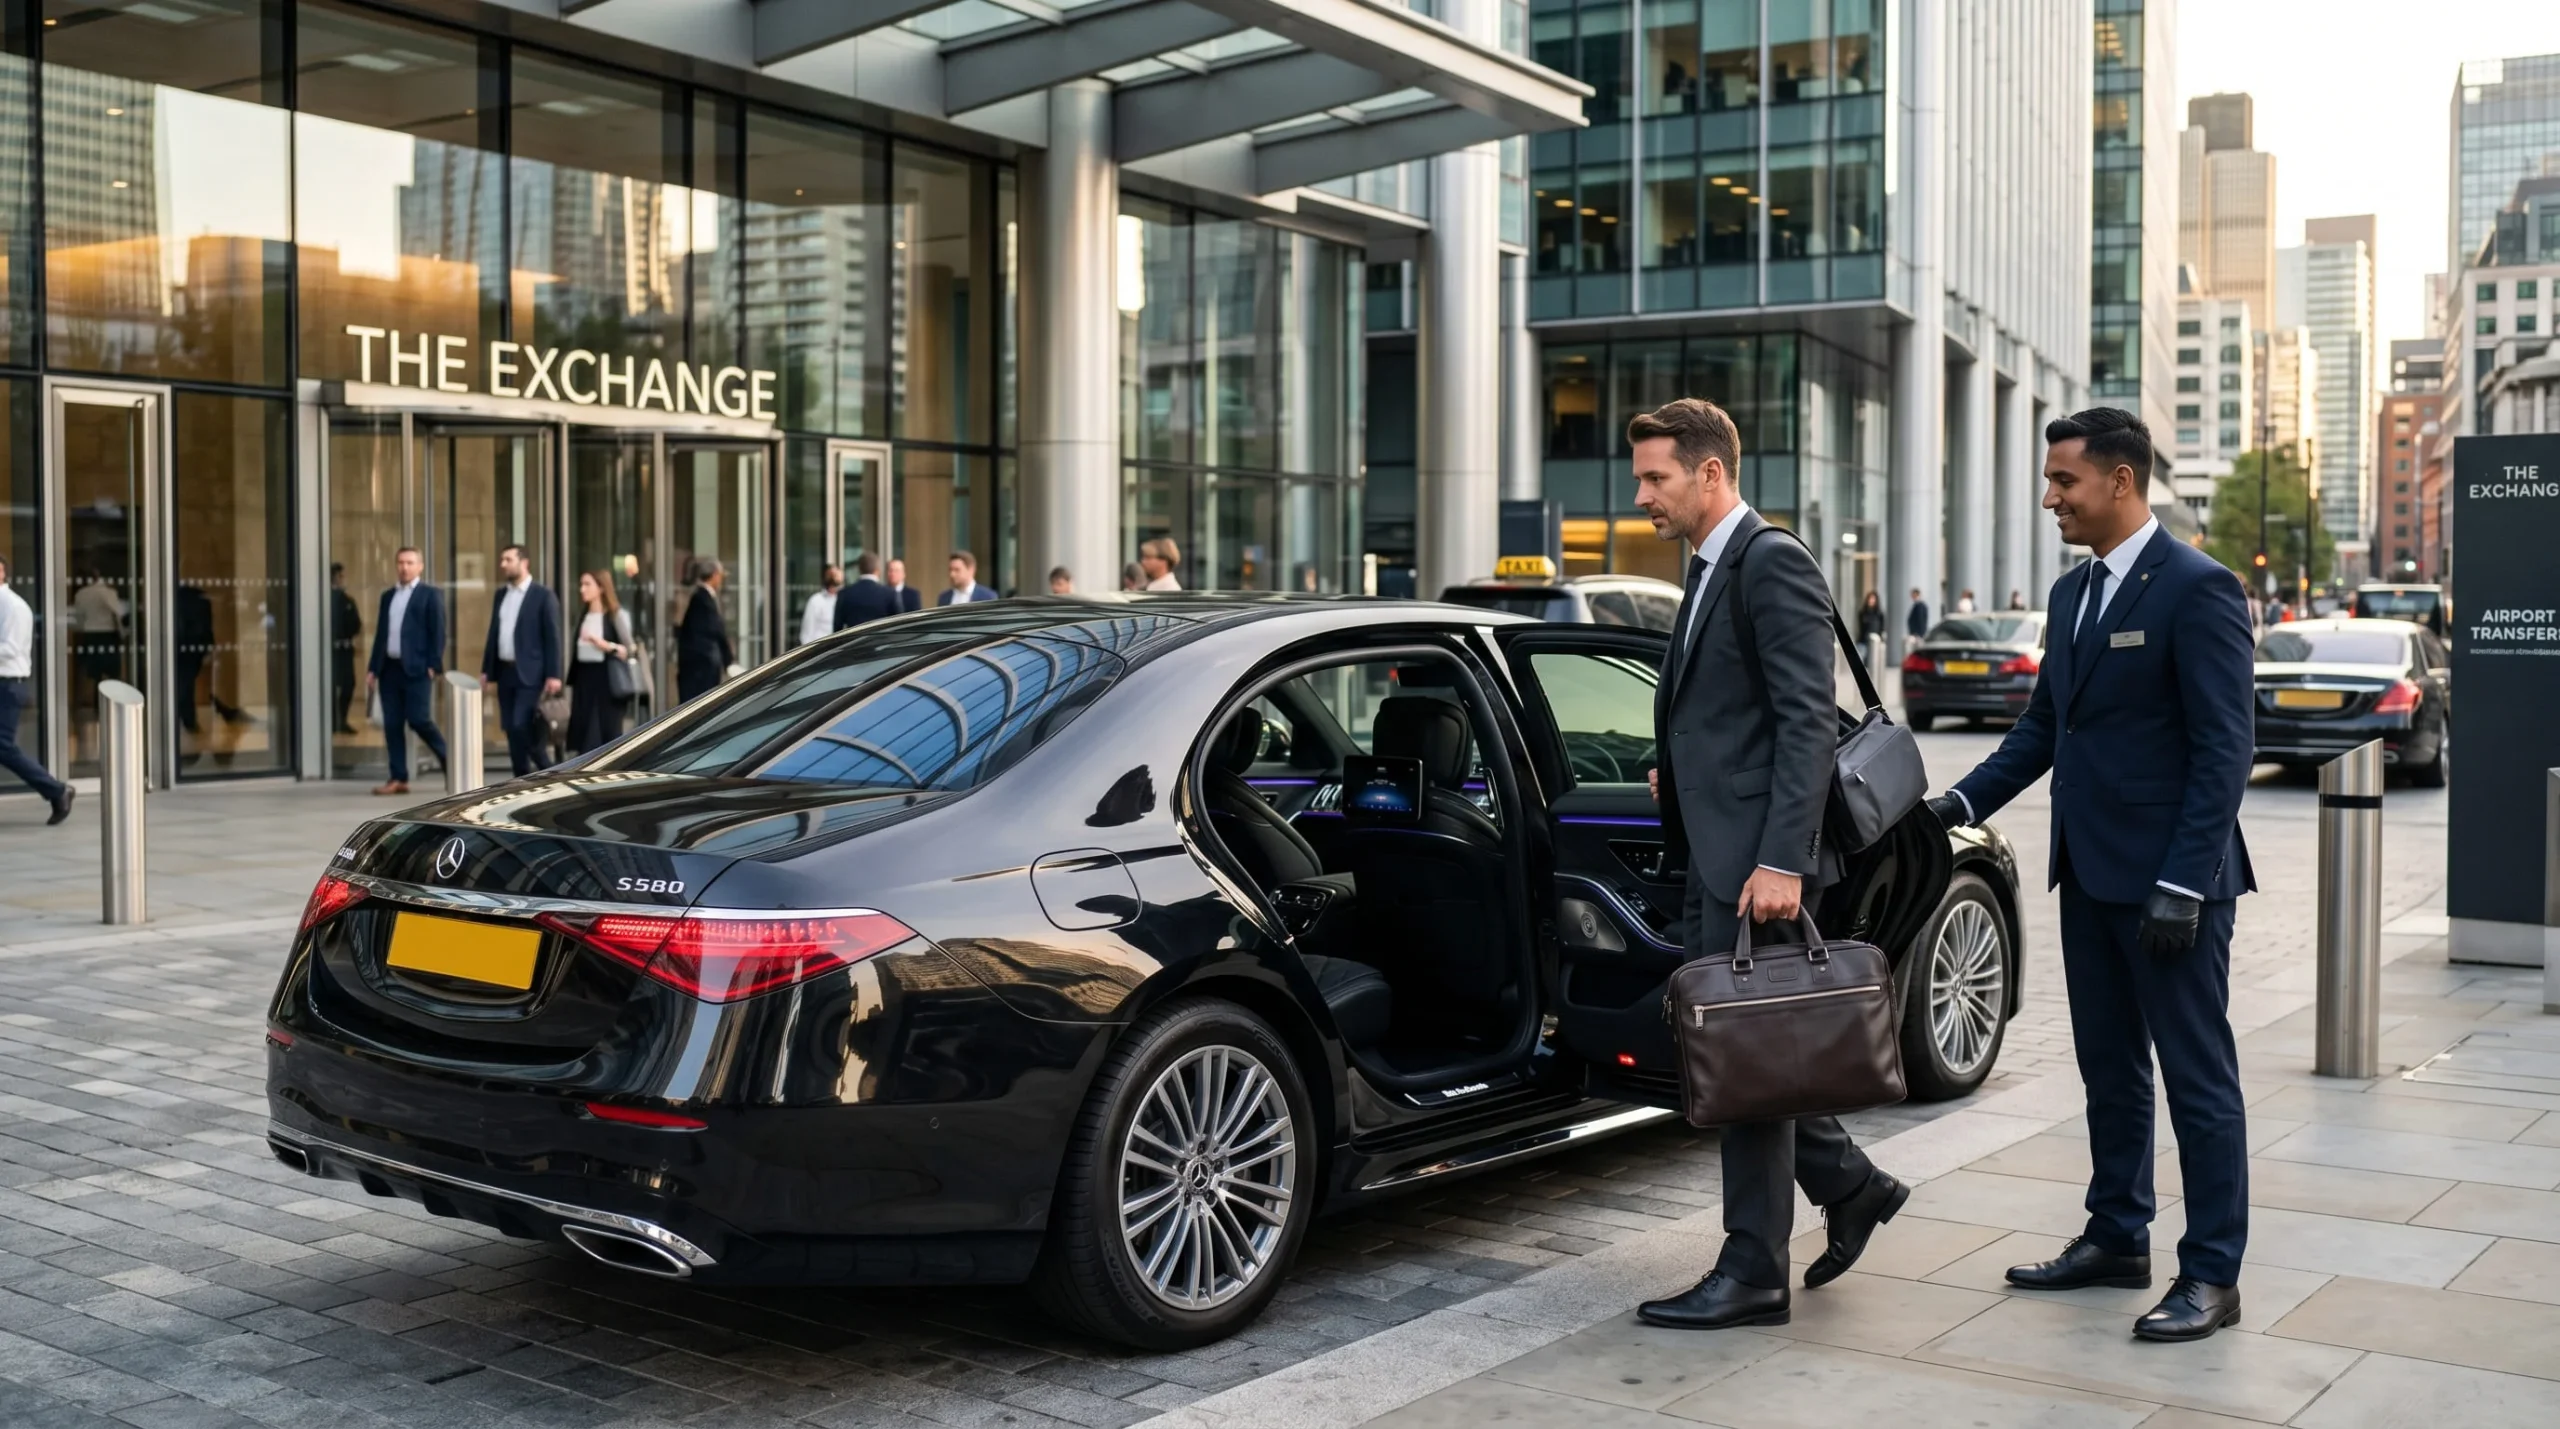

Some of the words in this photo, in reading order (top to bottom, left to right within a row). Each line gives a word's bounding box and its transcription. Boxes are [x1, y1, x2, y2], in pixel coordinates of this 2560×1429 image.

[345, 324, 468, 392] THE
[490, 340, 777, 421] EXCHANGE
[2503, 465, 2539, 480] THE
[2469, 482, 2560, 499] EXCHANG
[1503, 560, 1541, 573] TAXI
[2481, 609, 2556, 623] AIRPORT
[2470, 626, 2560, 641] TRANSFER
[616, 877, 685, 894] S580
